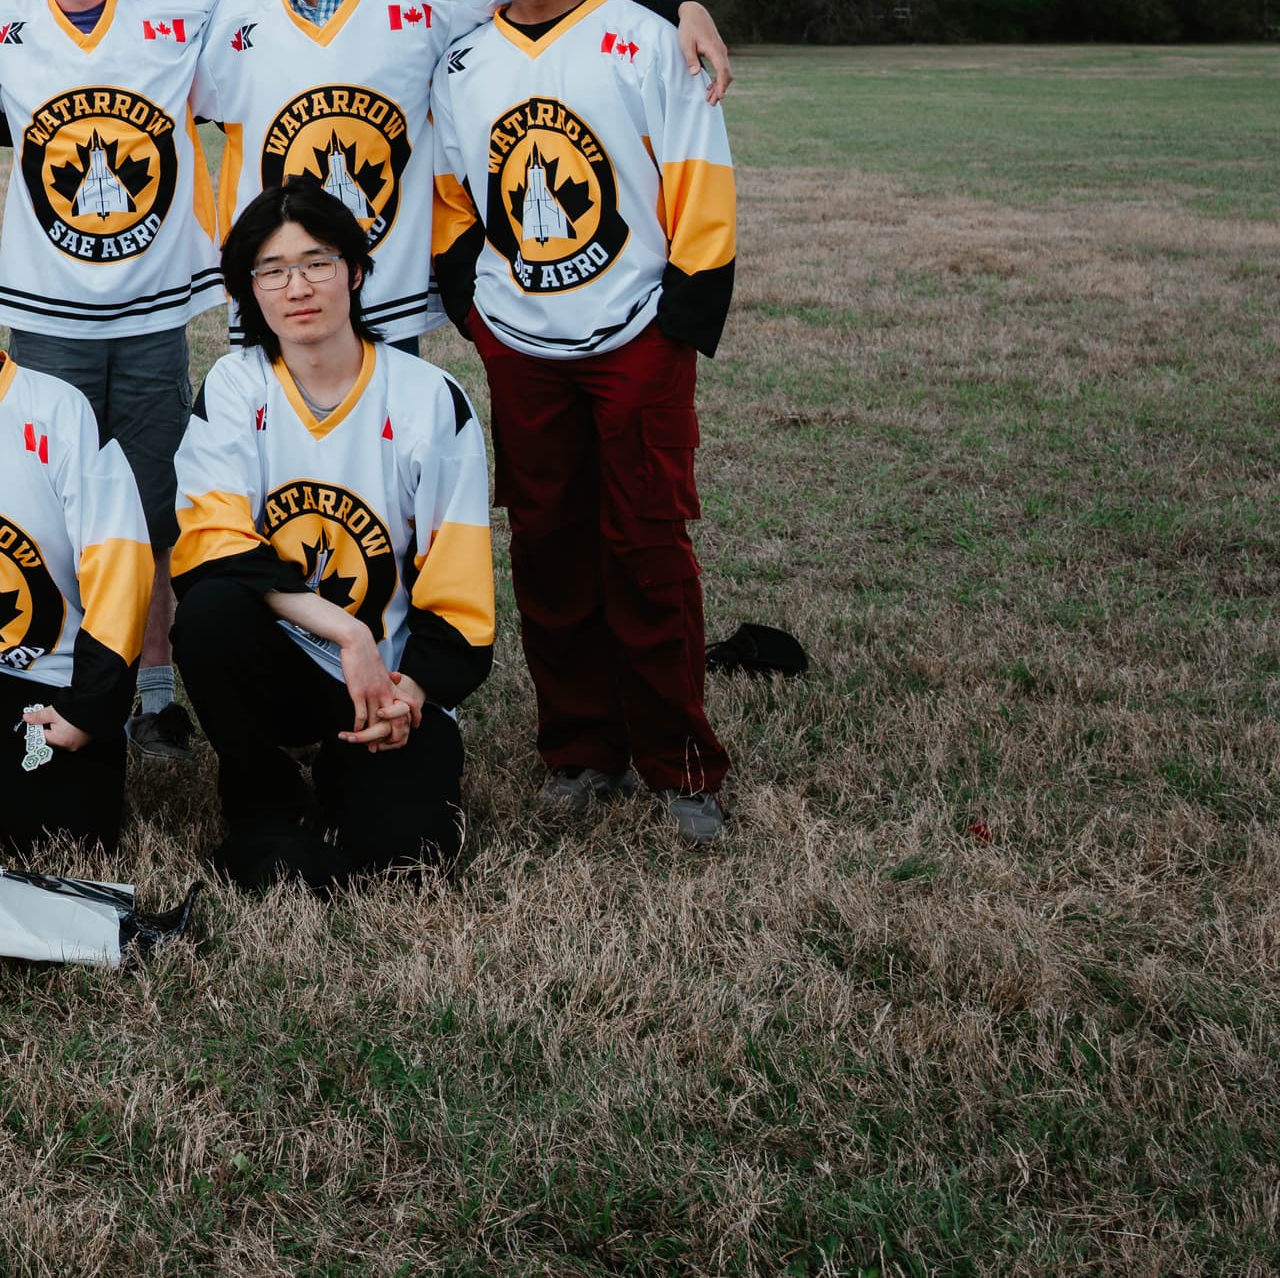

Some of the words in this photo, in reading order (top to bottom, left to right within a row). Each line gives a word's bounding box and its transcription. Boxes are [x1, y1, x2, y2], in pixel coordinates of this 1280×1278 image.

[27, 91, 172, 146] WATARROW
[266, 90, 405, 156] WATARROW
[49, 220, 96, 257] SAE
[101, 213, 160, 258] AERO
[541, 242, 609, 288] AERO
[264, 486, 391, 557] ATARROW
